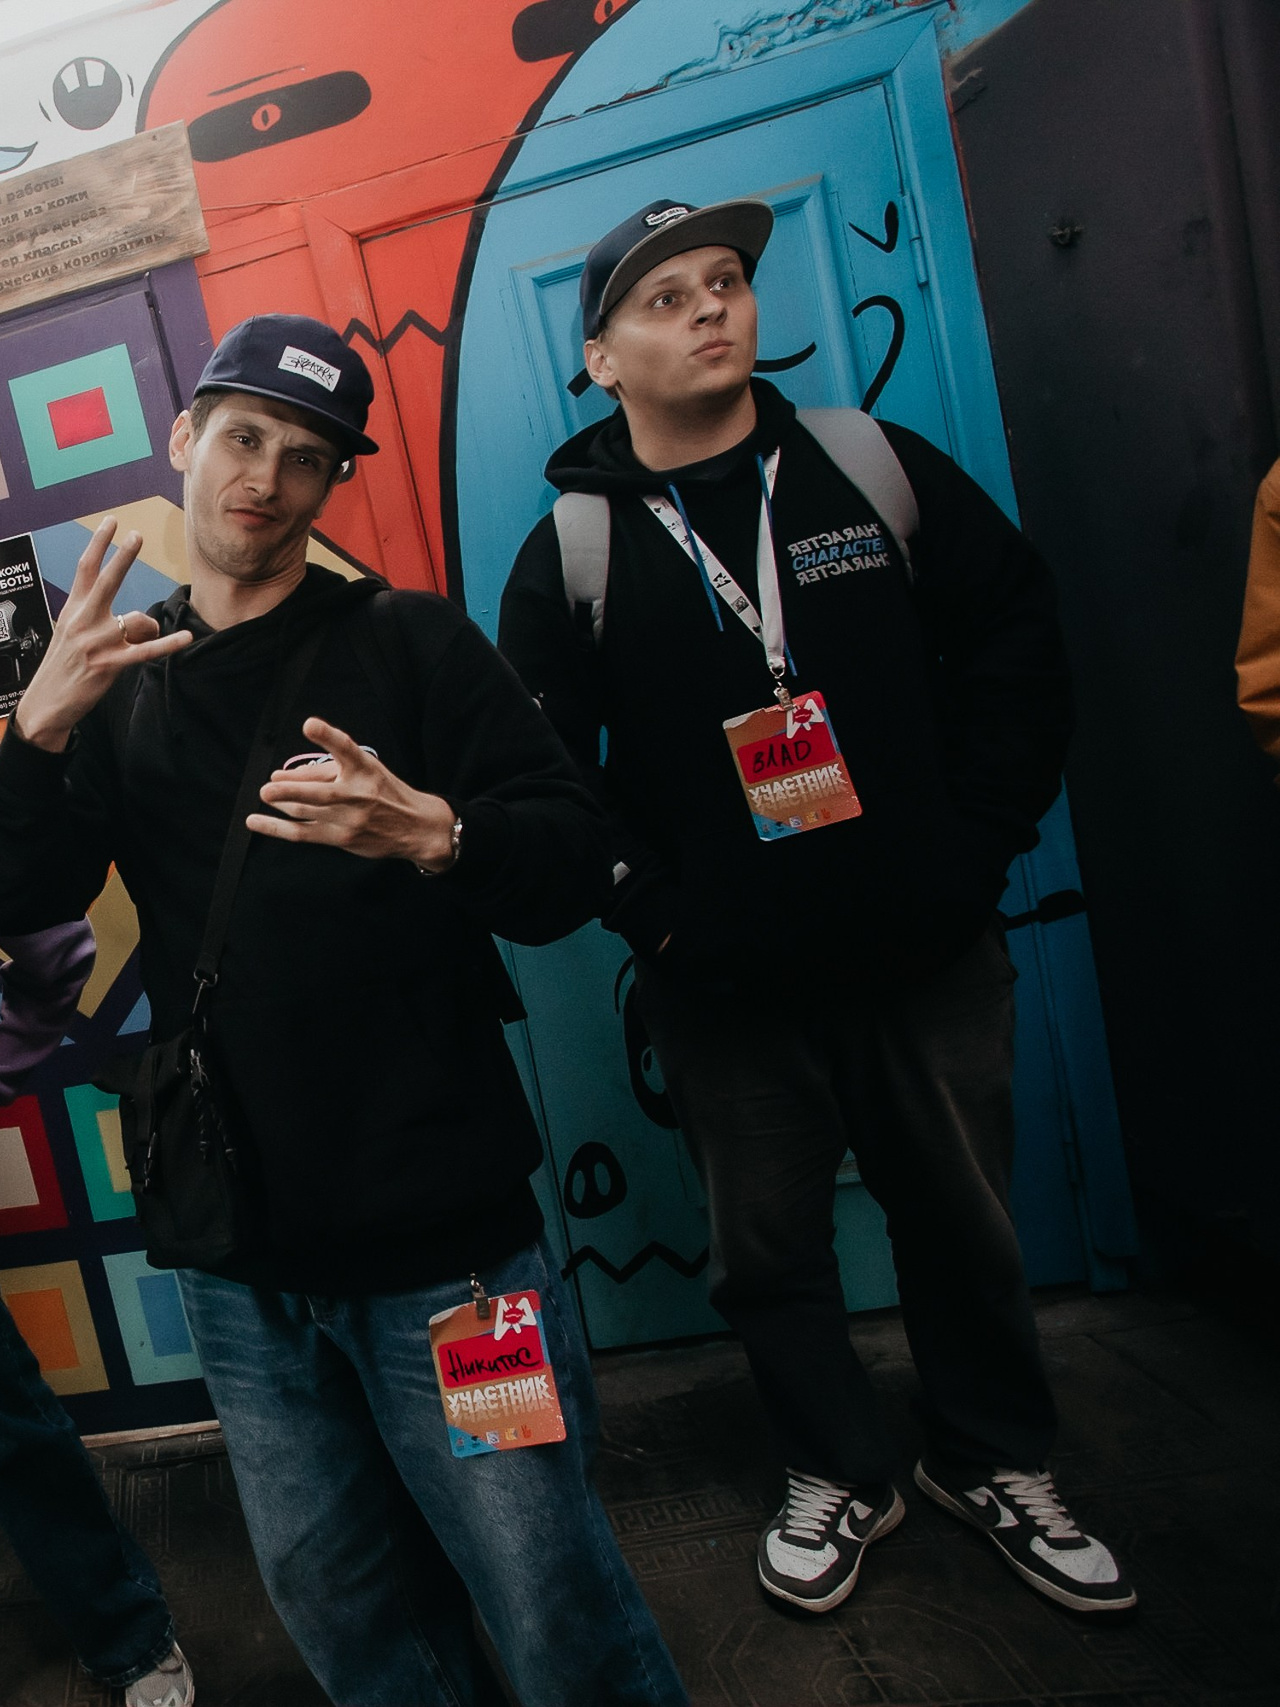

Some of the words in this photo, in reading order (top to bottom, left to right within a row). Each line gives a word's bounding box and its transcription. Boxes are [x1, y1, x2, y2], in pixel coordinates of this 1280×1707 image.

[23, 204, 43, 218] из
[47, 190, 89, 211] кожи
[23, 235, 83, 260] классы
[749, 763, 844, 801] УЧАСТНИК
[446, 1374, 552, 1411] УЧАСТНИК
